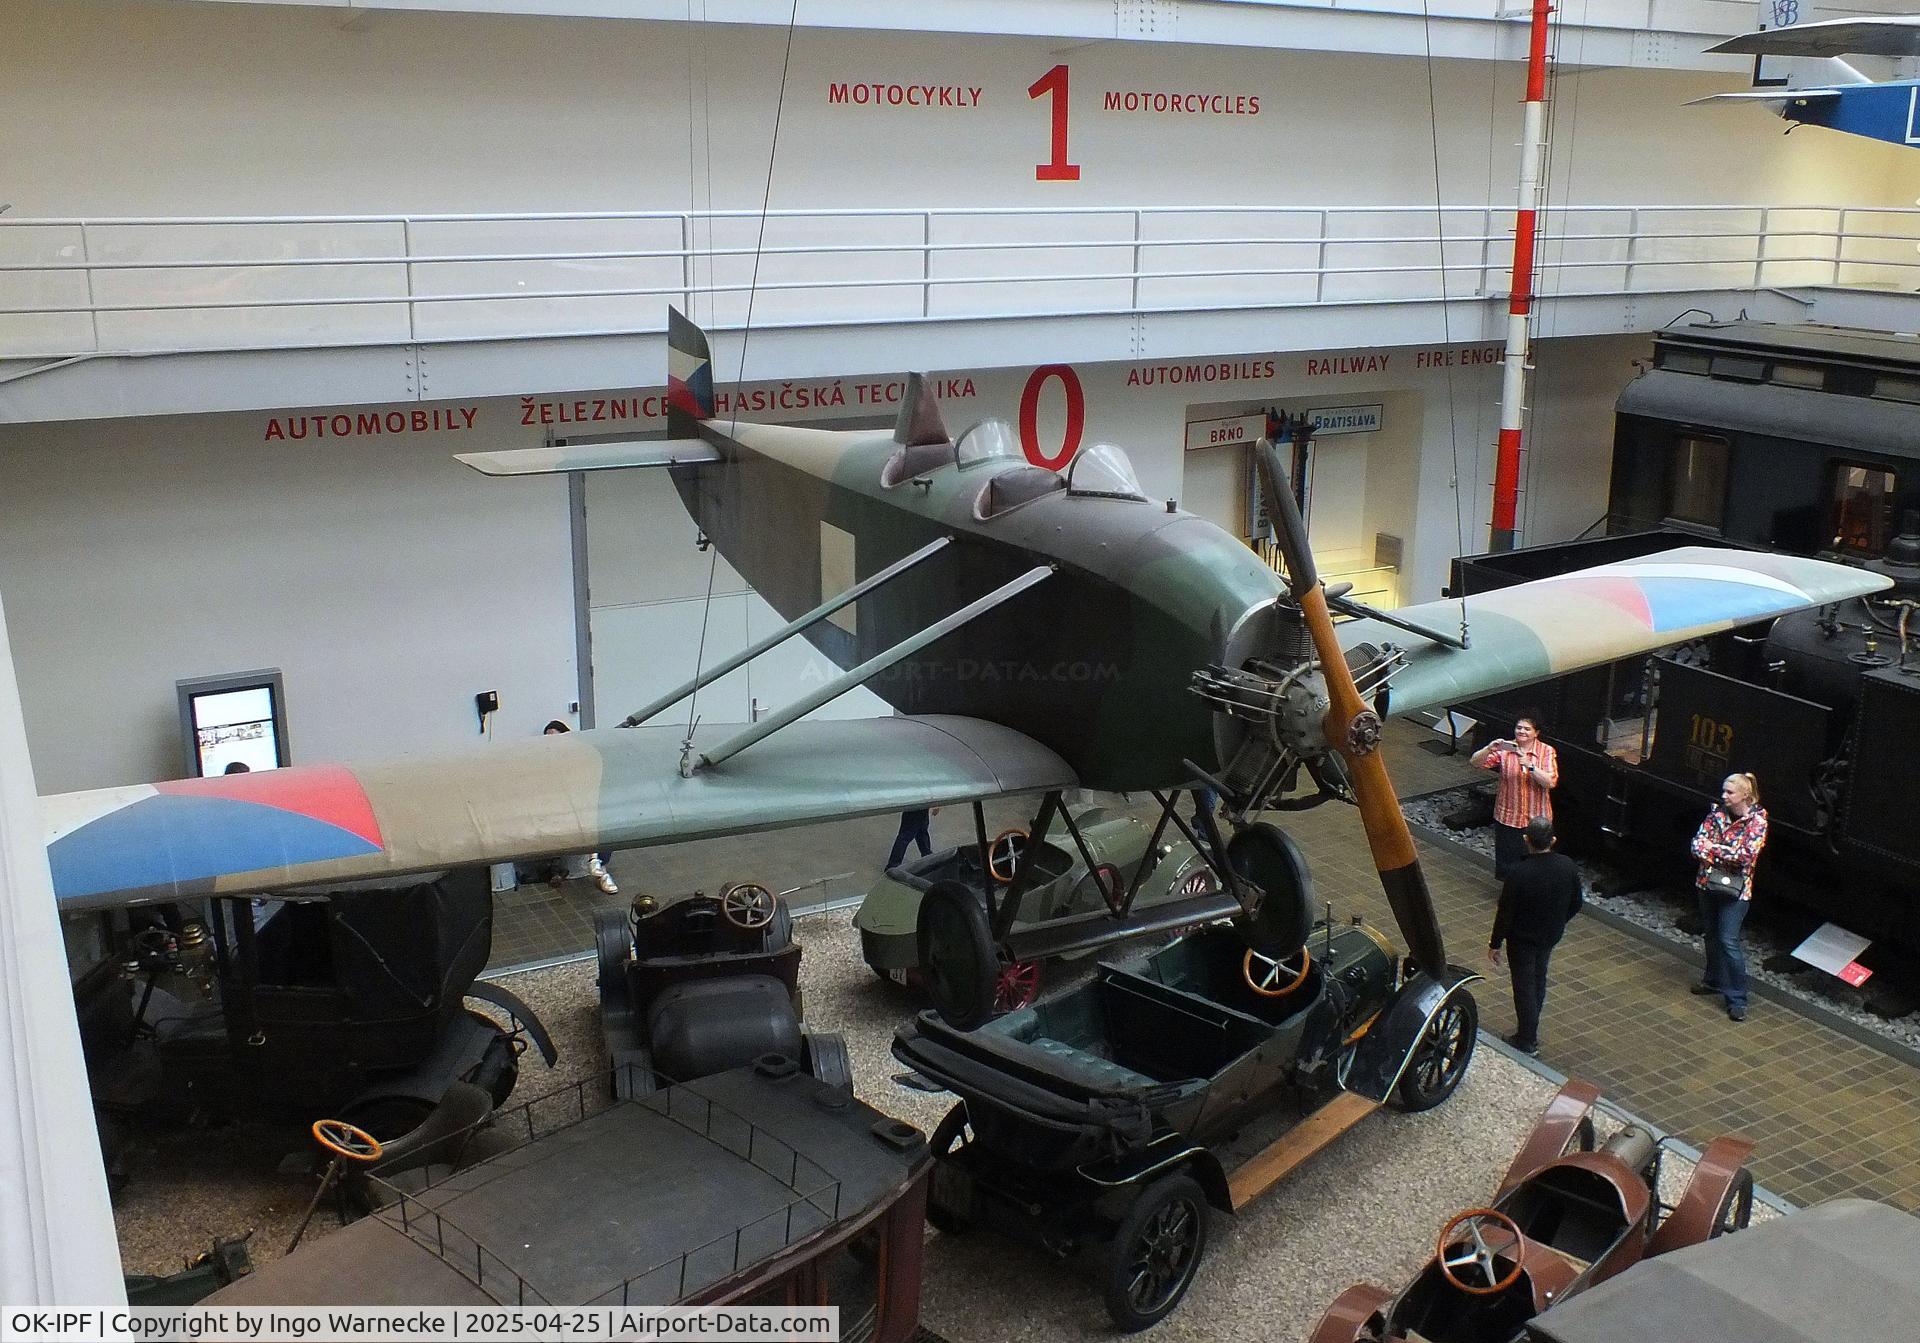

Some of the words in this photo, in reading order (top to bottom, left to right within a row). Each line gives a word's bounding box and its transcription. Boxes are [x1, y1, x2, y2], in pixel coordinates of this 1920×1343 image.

[828, 83, 983, 108] MOTOCYKLY
[1103, 91, 1261, 115] MOTORCYCLES
[1027, 64, 1081, 181] 1
[1307, 353, 1391, 376] RAILWAY
[1416, 350, 1453, 368] FIRE
[1127, 361, 1275, 386] AUTOMOBILES
[714, 380, 845, 413] HASIČSKÁ
[855, 378, 976, 404] TECIKA
[264, 407, 478, 441] AUTOMOBILY
[1019, 364, 1085, 472] 0
[1314, 414, 1376, 428] BRATISLAVA
[1210, 426, 1243, 443] BRNO
[1689, 713, 1734, 753] 103
